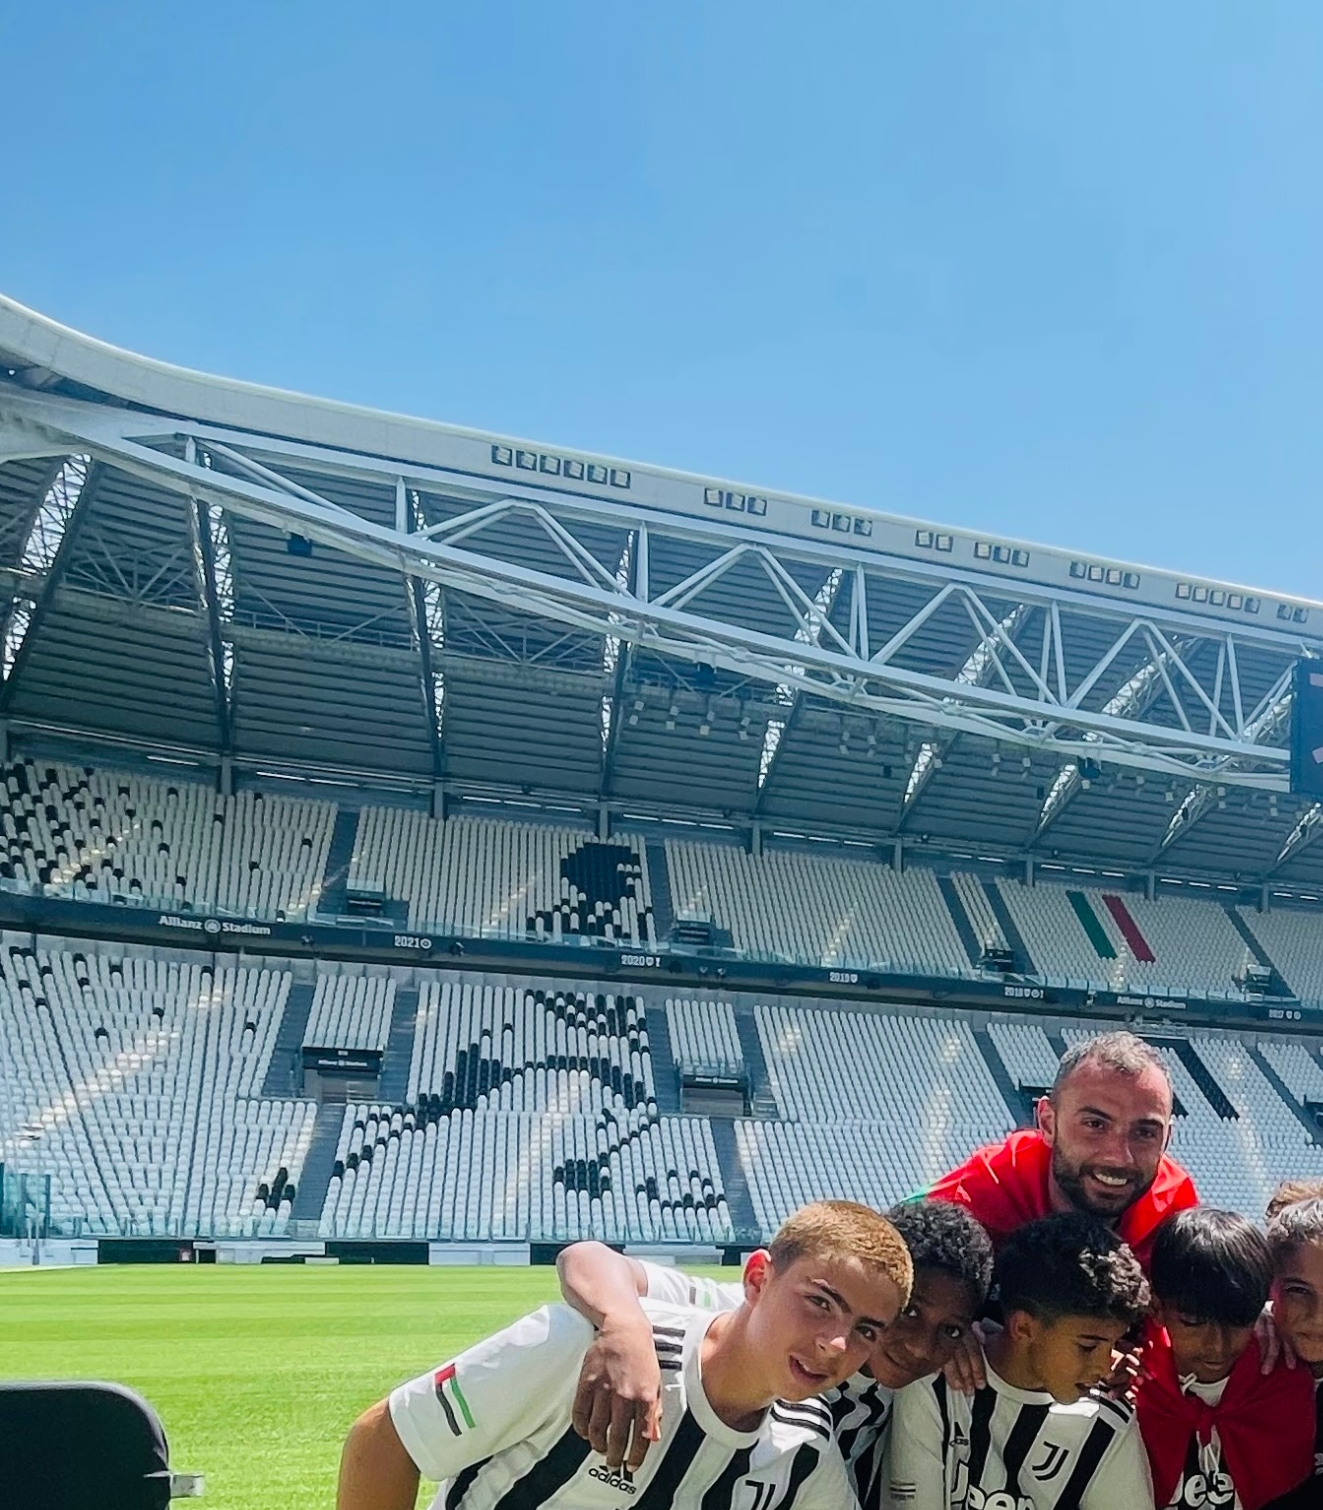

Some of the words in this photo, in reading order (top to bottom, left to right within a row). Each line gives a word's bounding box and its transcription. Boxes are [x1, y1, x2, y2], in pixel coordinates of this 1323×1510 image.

[158, 915, 203, 930] Allianz
[222, 922, 271, 935] Stadium
[394, 935, 420, 948] 2021
[621, 954, 645, 967] 2020
[1155, 999, 1187, 1009] Stadium
[588, 1466, 638, 1495] adidas
